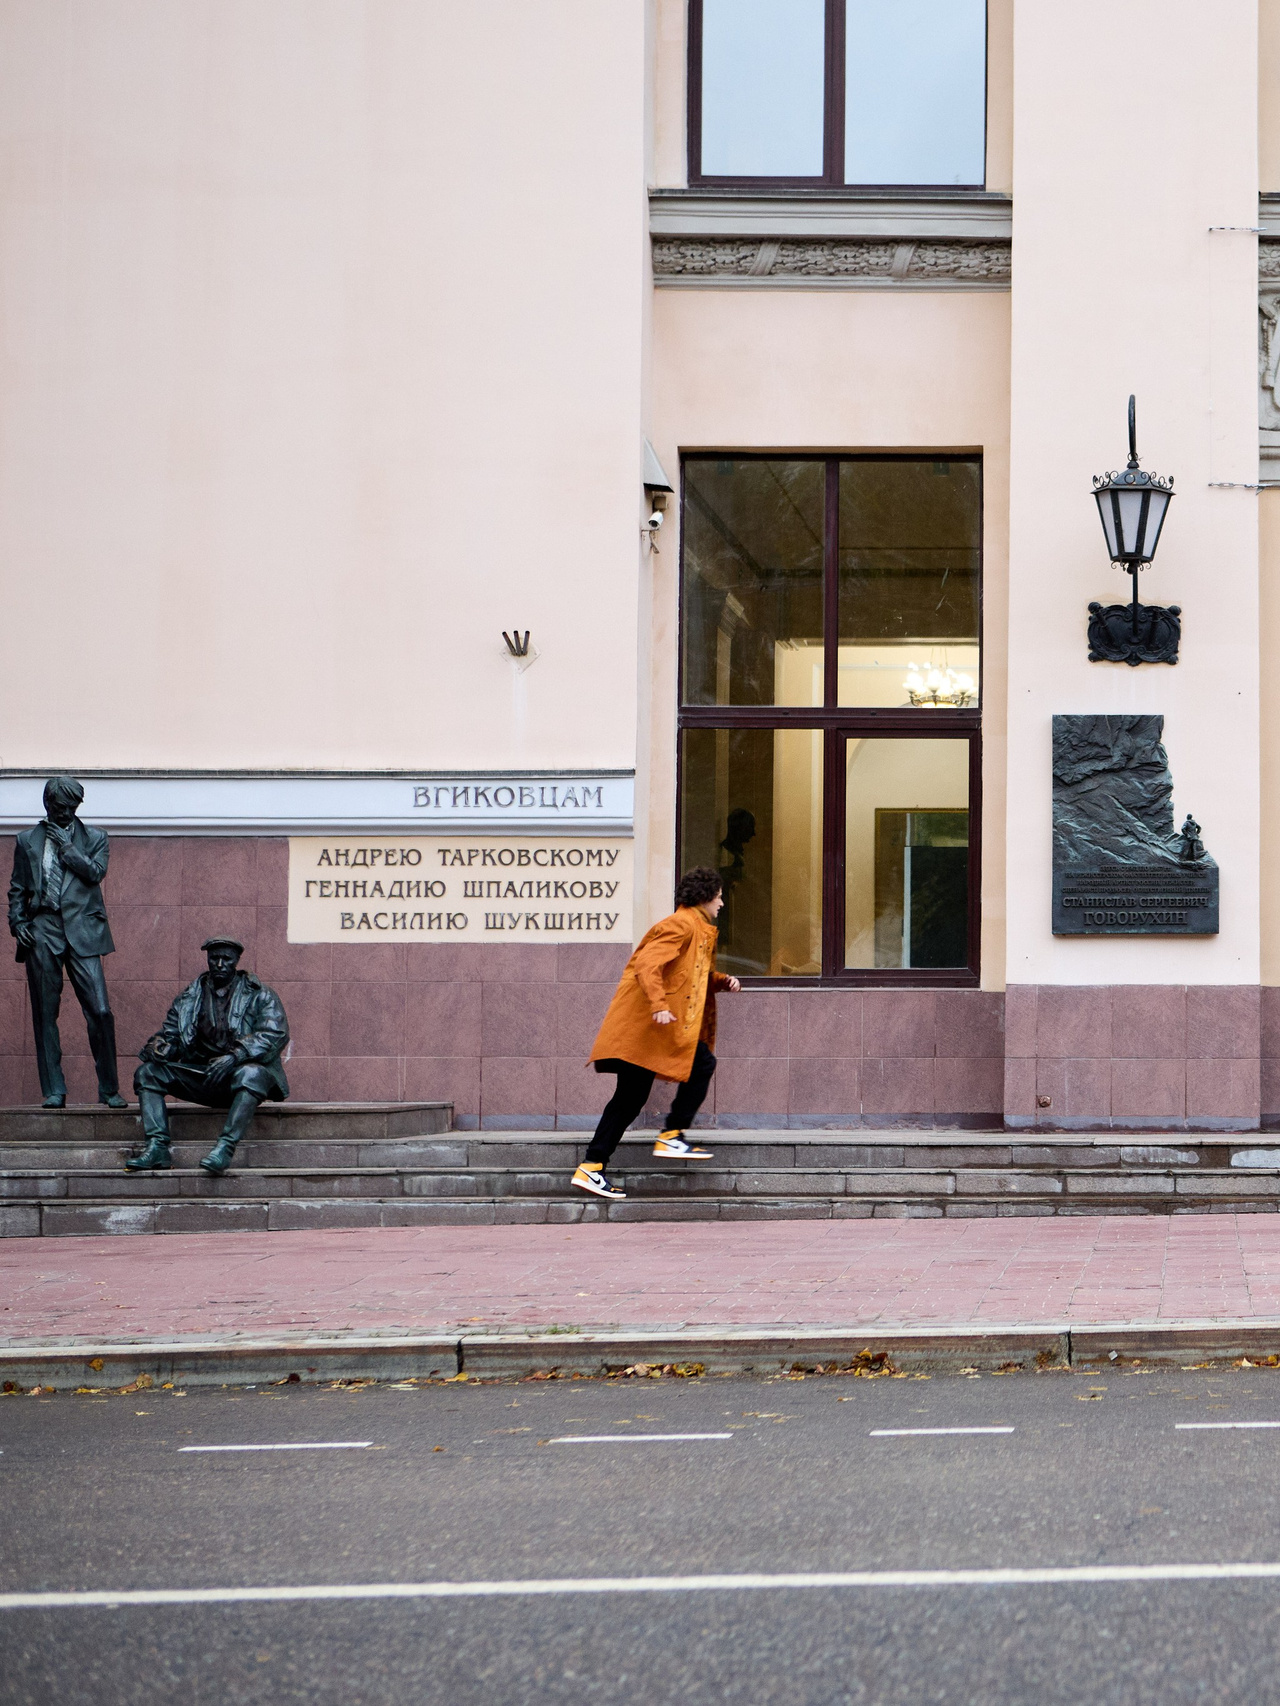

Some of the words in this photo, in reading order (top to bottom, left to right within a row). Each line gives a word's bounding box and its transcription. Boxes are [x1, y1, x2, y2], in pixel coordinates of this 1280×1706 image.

[413, 786, 604, 811] ВГИКОВЦАМ
[317, 848, 422, 869] АНДРЕЮ
[437, 848, 620, 867] ТАРКОВСКОМУ
[305, 880, 446, 901] ГЕННАДИЮ
[463, 880, 620, 899] ШПАЛИКОВУ
[1062, 896, 1136, 908] СТАНИСЛАВ
[1140, 896, 1209, 908] СЕРГЕЕВИЧ
[340, 912, 468, 931] ВАСИЛИЮ
[485, 912, 619, 931] ШУКШИНУ
[1084, 911, 1188, 926] ГОВОРУХИН
